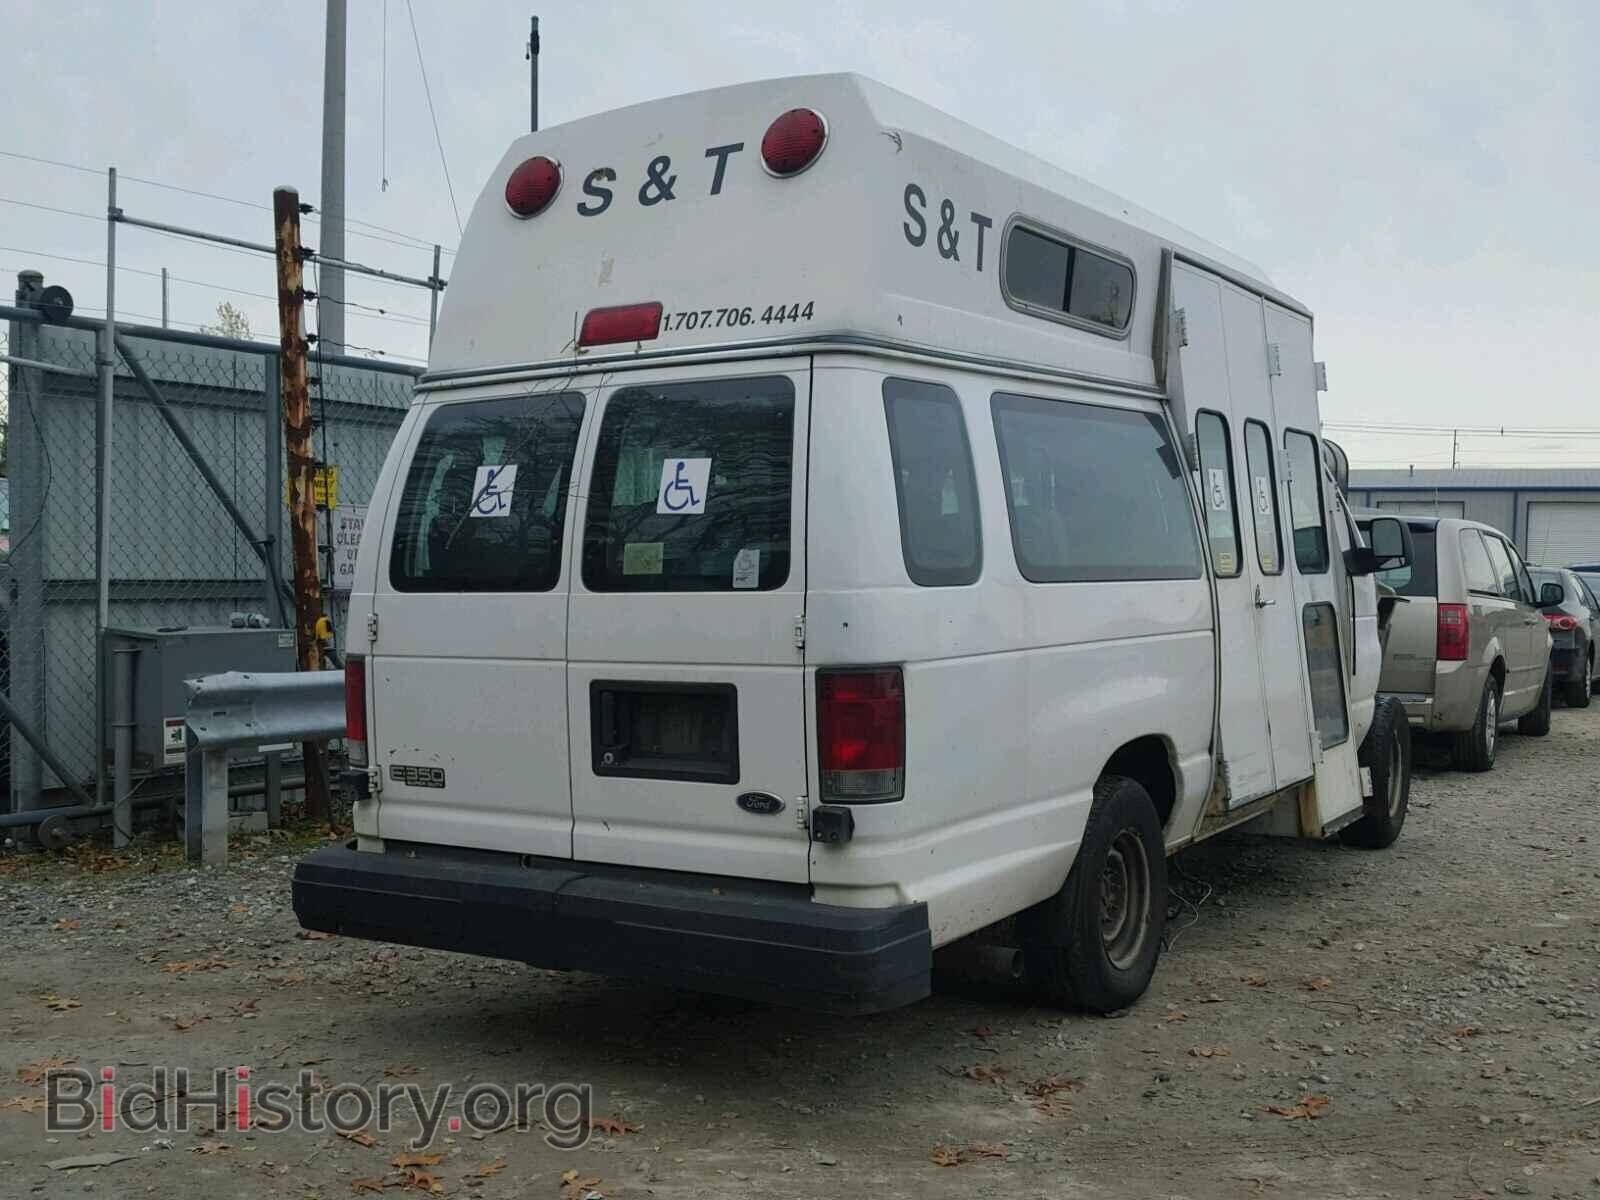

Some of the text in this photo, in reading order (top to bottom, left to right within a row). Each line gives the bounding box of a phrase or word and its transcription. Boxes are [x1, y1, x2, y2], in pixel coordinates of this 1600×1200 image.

[576, 142, 744, 217] S & T
[903, 183, 993, 272] S & T
